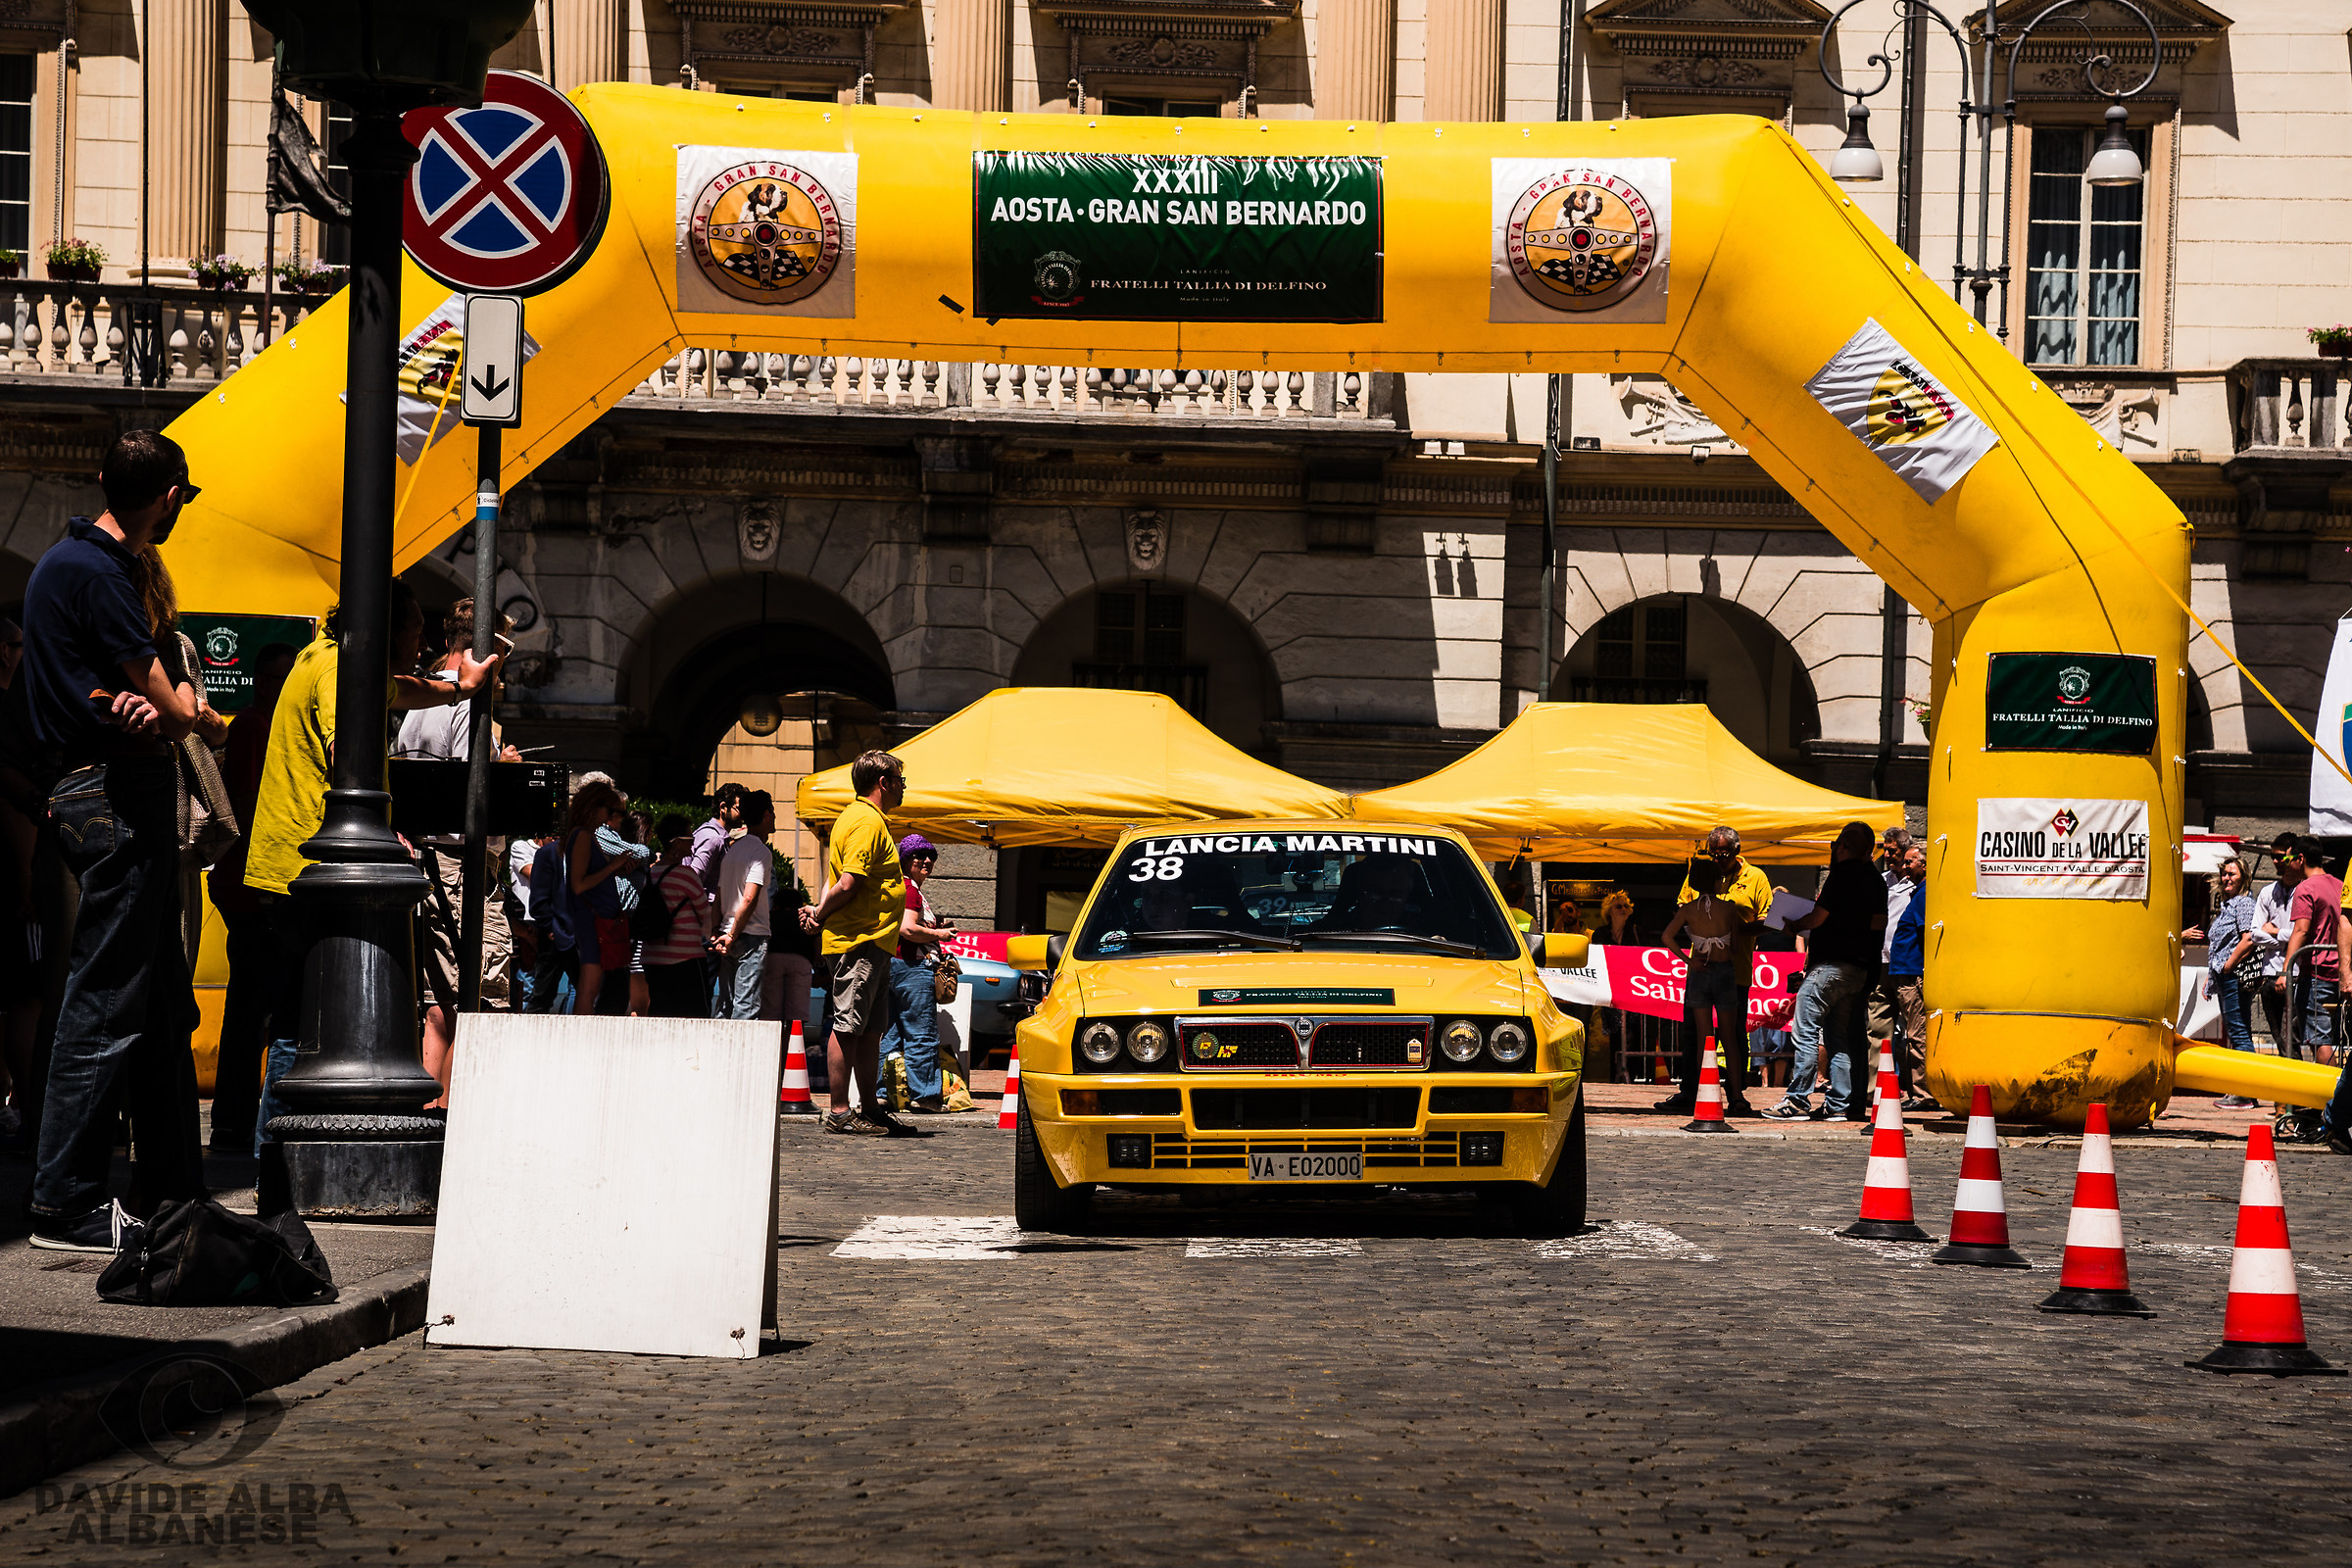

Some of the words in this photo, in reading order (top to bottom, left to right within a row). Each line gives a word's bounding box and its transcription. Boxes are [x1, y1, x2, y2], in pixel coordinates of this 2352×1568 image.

[1132, 169, 1218, 194] XXXIII
[694, 214, 715, 269] AOSTA
[713, 165, 758, 193] GRAN
[768, 165, 802, 184] SAN
[807, 183, 838, 275] BERNARDO
[1166, 200, 1218, 225] SAN
[1226, 200, 1366, 225] BERNARDO
[1510, 221, 1531, 276] AOSTA
[1582, 172, 1615, 189] SAN
[1621, 187, 1653, 277] BERNARDO
[1090, 279, 1169, 289] FRATELLI
[1174, 280, 1232, 290] TALLIA
[1235, 281, 1251, 290] DI
[1255, 281, 1327, 291] DELFINO
[202, 676, 237, 685] ALLIA
[1992, 713, 2045, 722] FRATELLI
[2048, 713, 2089, 723] TALLIA
[2107, 716, 2153, 726] DELFINO
[1145, 836, 1277, 857] LANCIA
[1286, 835, 1438, 857] MARTINI
[1981, 831, 2045, 858] CASINO
[2052, 843, 2065, 858] DE
[2068, 843, 2082, 858] LA
[1128, 857, 1184, 882] 38
[2068, 864, 2101, 873] VALLE
[1251, 1156, 1275, 1177] VA
